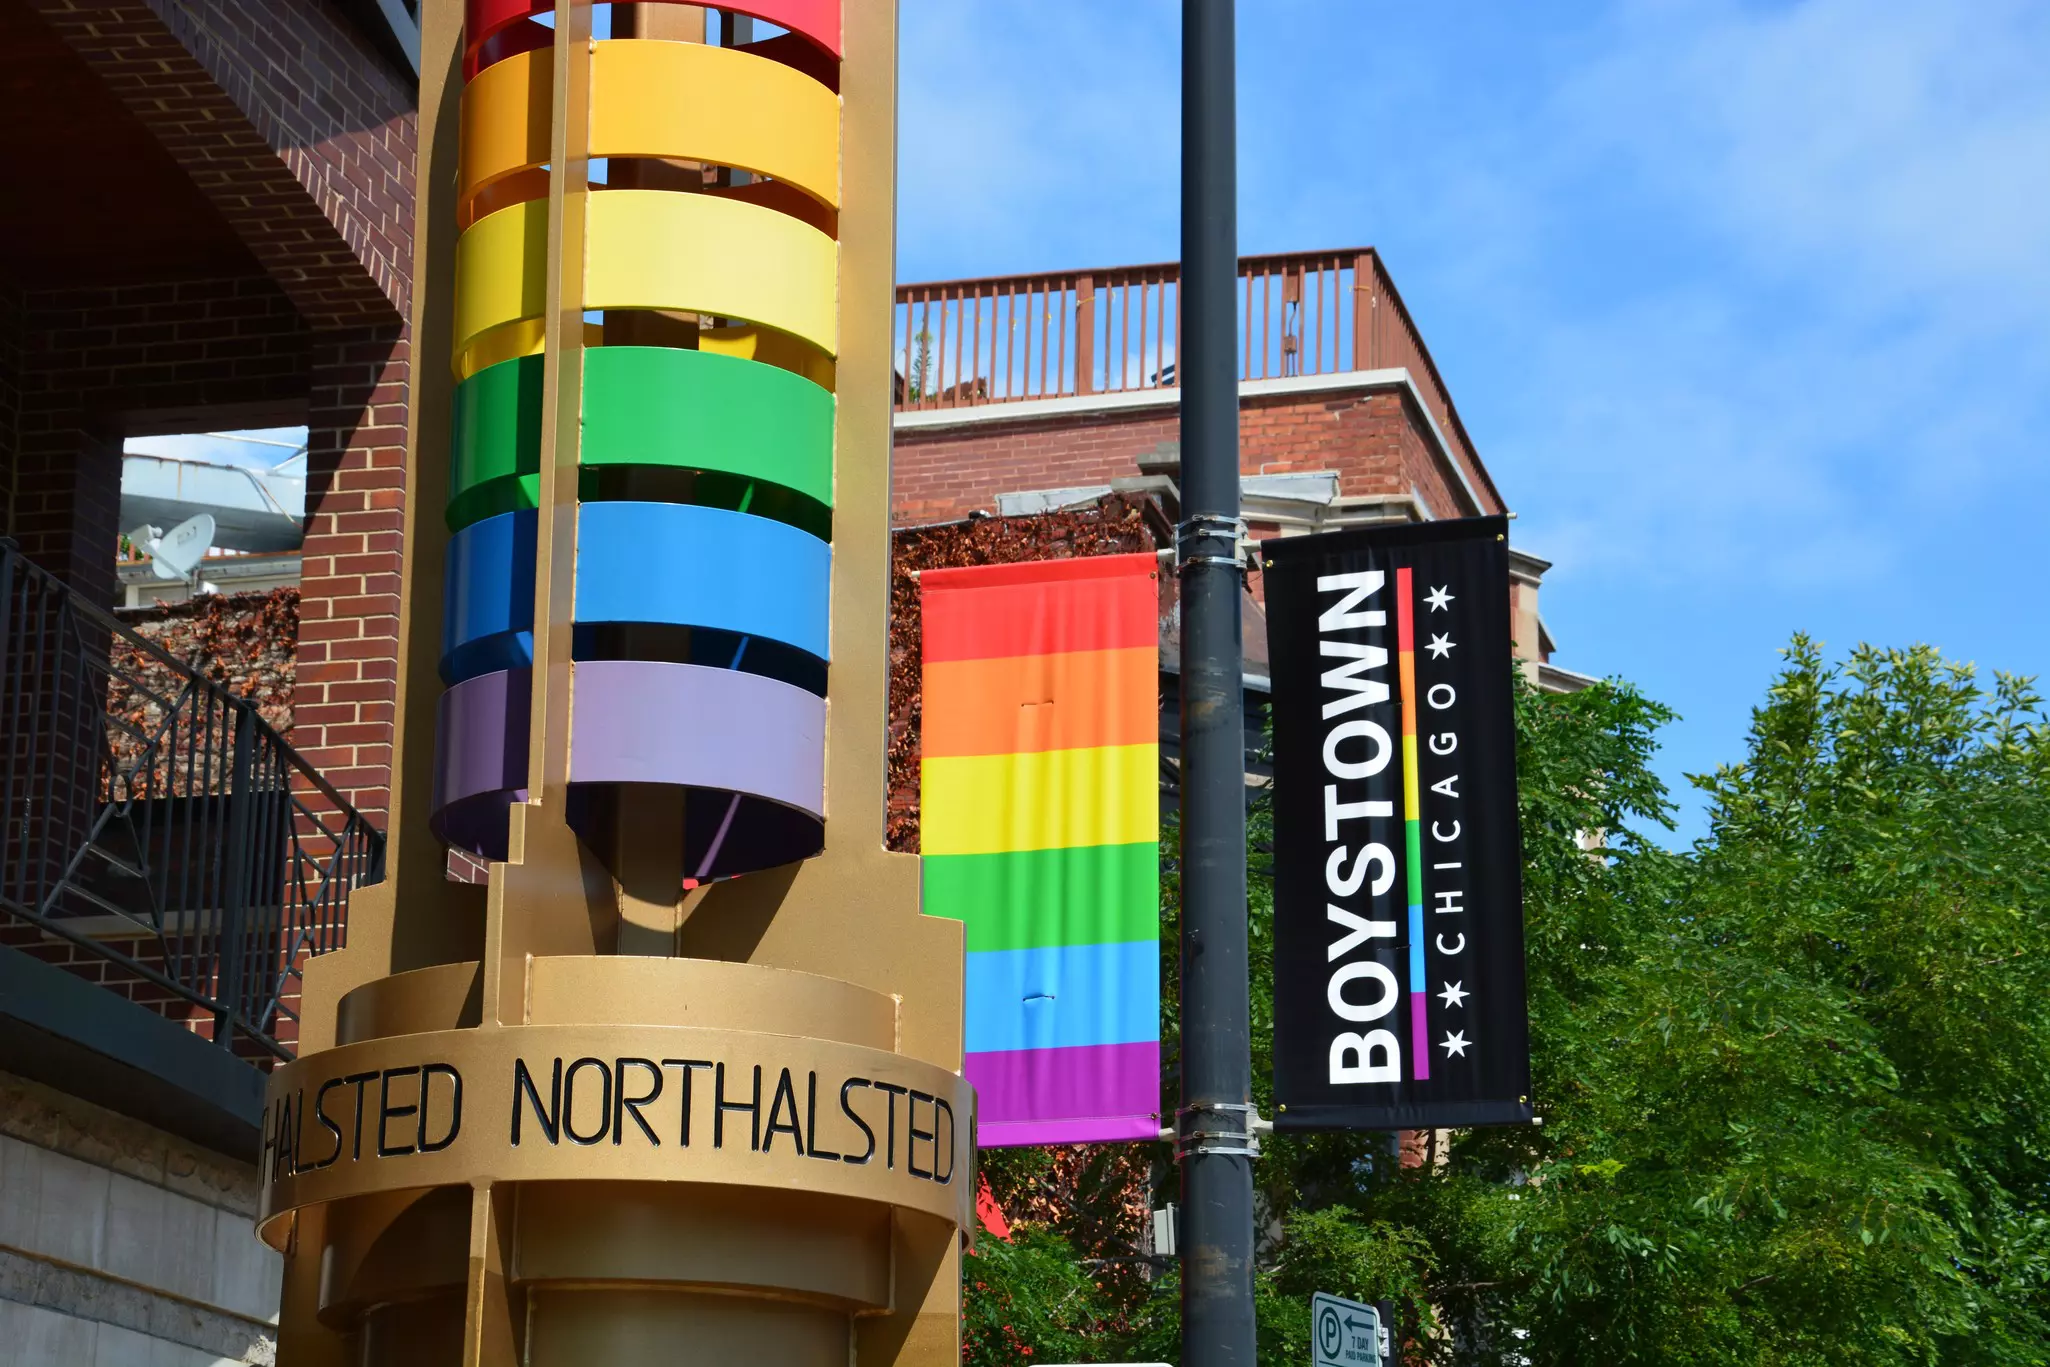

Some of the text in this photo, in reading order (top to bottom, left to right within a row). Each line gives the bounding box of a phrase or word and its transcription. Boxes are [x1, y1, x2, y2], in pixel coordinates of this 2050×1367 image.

[1316, 569, 1402, 1085] BOYSTOWN
[1426, 683, 1466, 956] CHICAGO
[260, 1063, 463, 1188] HALSTED
[511, 1057, 955, 1185] NORTHALSTED
[1351, 1335, 1369, 1351] 7 DAY
